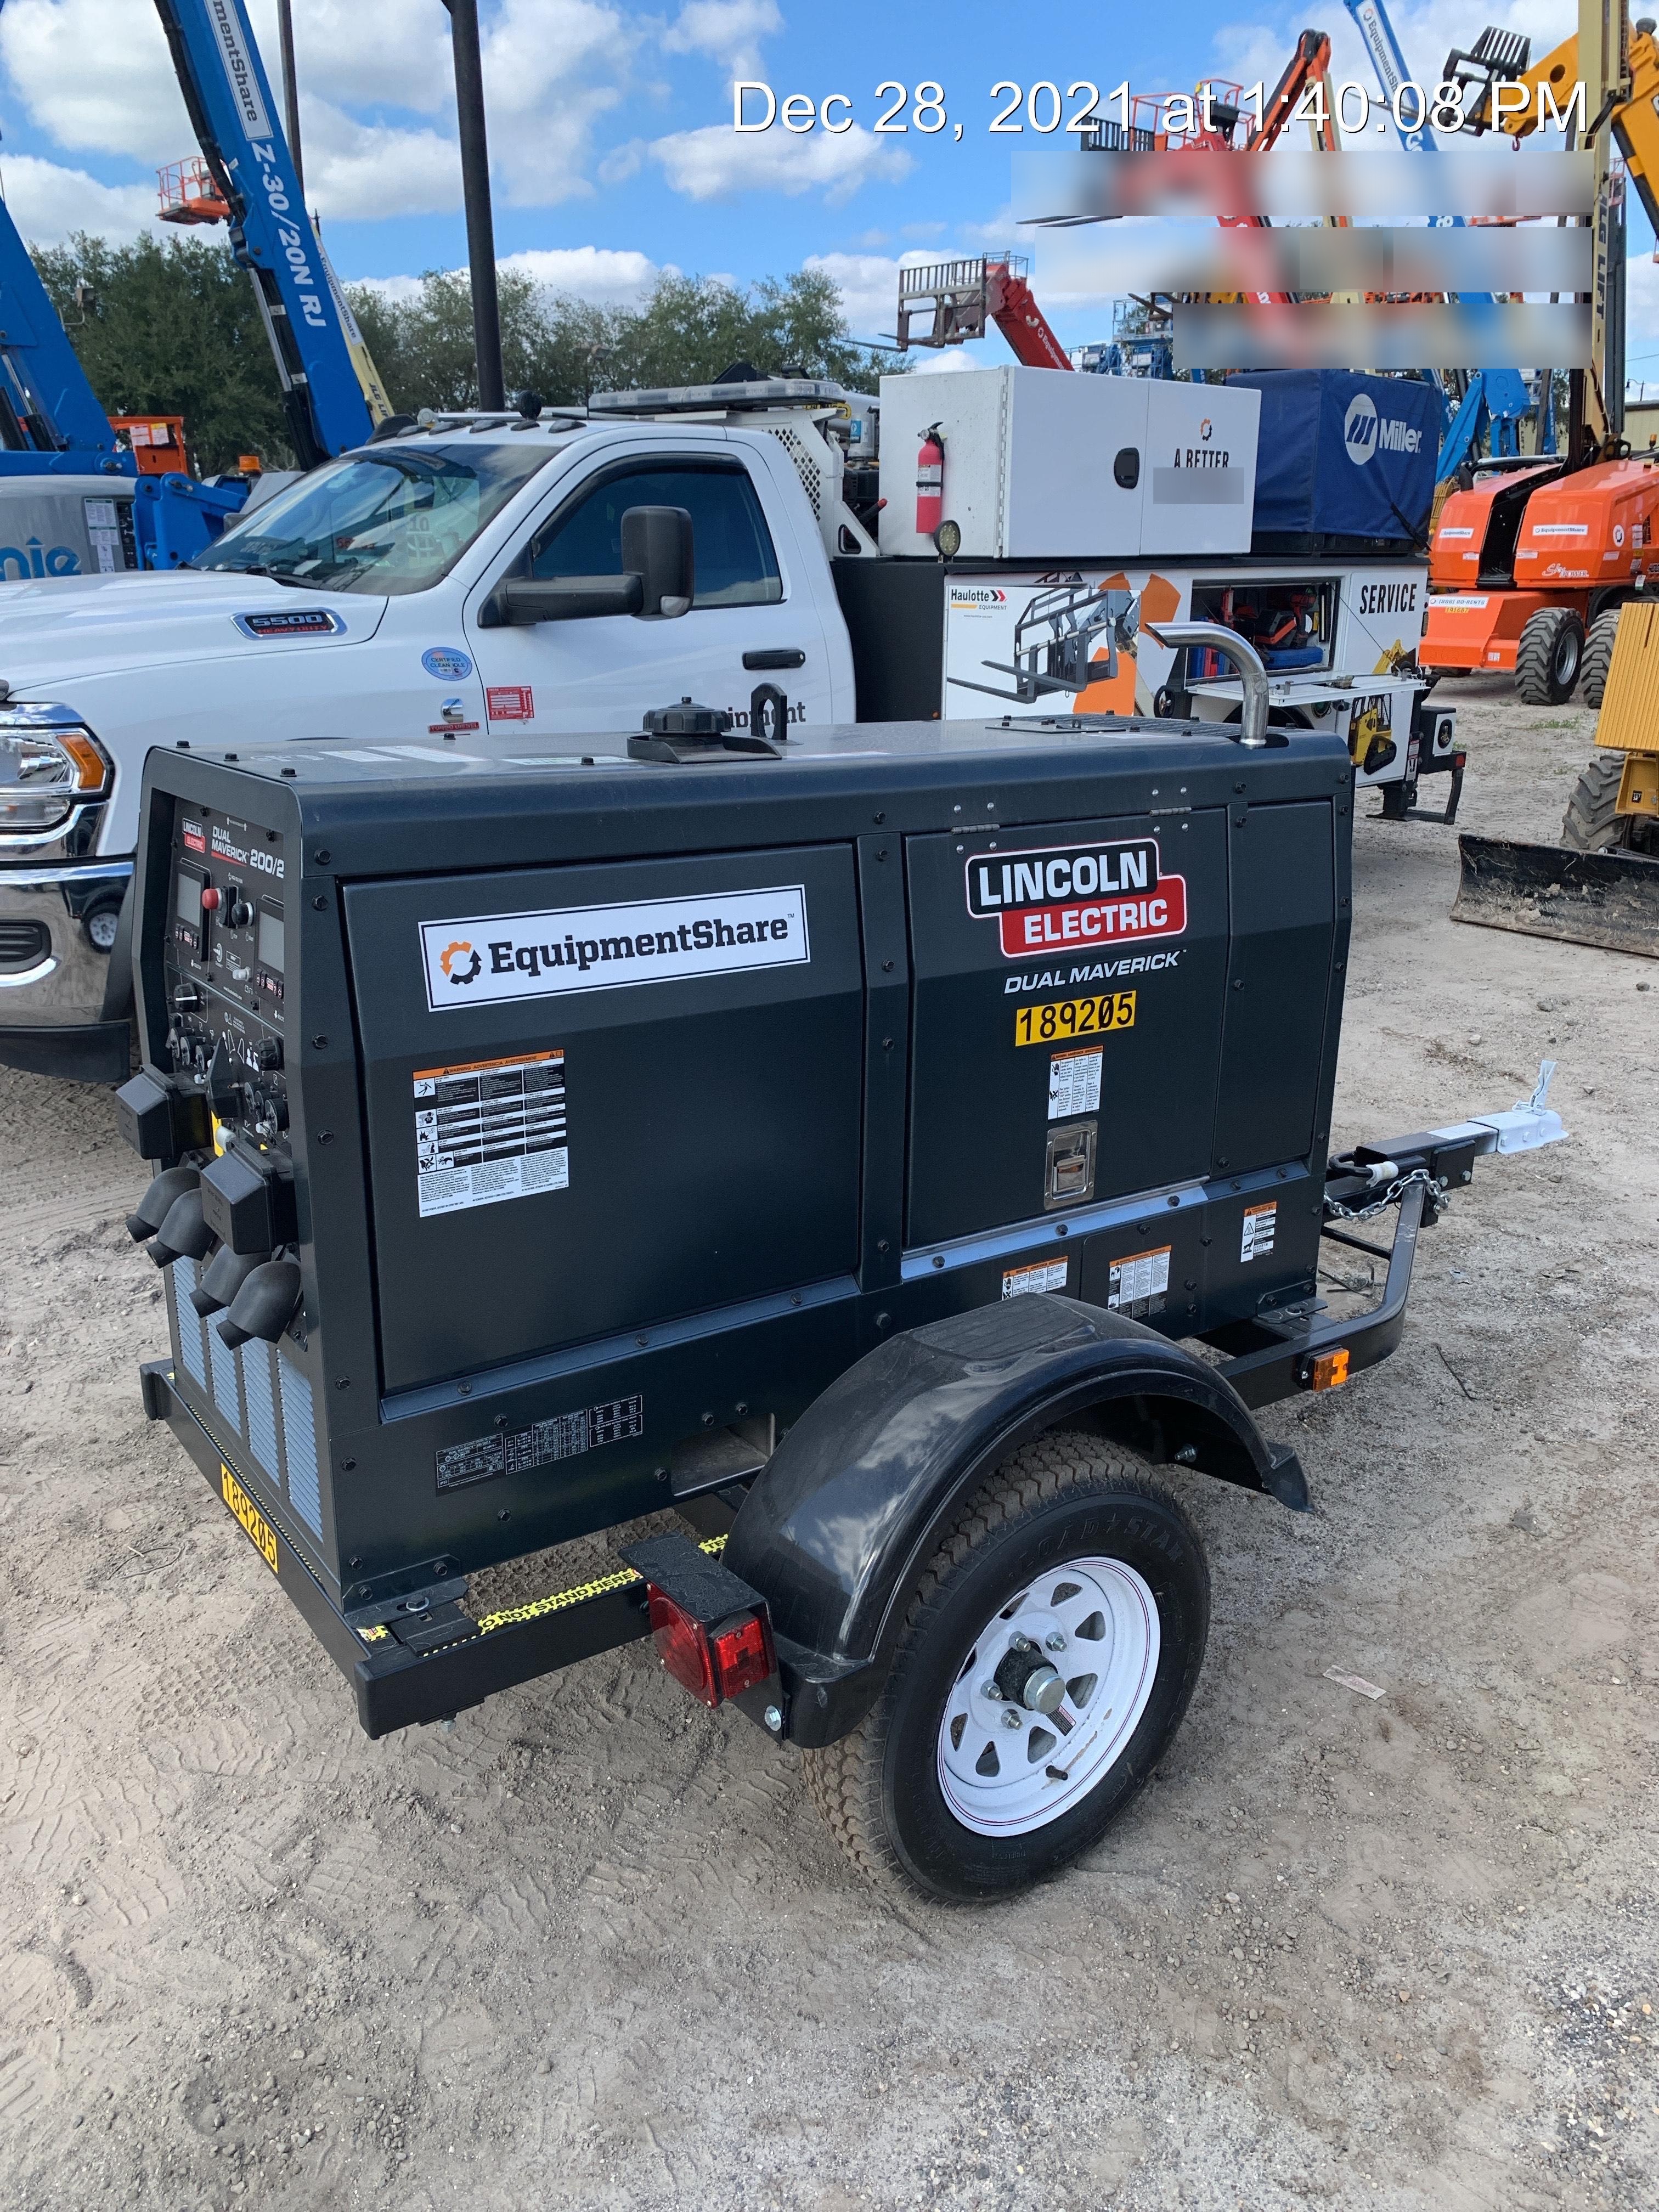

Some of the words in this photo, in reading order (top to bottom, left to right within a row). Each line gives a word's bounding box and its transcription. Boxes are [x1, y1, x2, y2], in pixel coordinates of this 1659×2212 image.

[251, 142, 313, 286] Z-30/20N
[299, 294, 327, 328] RJ
[1596, 254, 1608, 321] LIFT
[369, 381, 382, 402] JLG
[1379, 418, 1423, 453] Miller
[1174, 448, 1181, 468] A
[951, 589, 990, 602] Haulotte
[1359, 583, 1418, 615] SERVICE
[211, 838, 247, 864] MAVERICK
[212, 825, 231, 844] DUAL
[979, 850, 1148, 906] LINCOLN
[1024, 899, 1168, 944] ELECTRIC
[488, 918, 788, 977] EquipmentShare
[1004, 970, 1065, 994] DUAL
[1069, 950, 1181, 984] MAVERICK
[1020, 992, 1133, 1042] 189205
[223, 1471, 275, 1566] 189205
[499, 1607, 532, 1621] NOT
[537, 1588, 590, 1612] STAND
[590, 1572, 633, 1590] HERE
